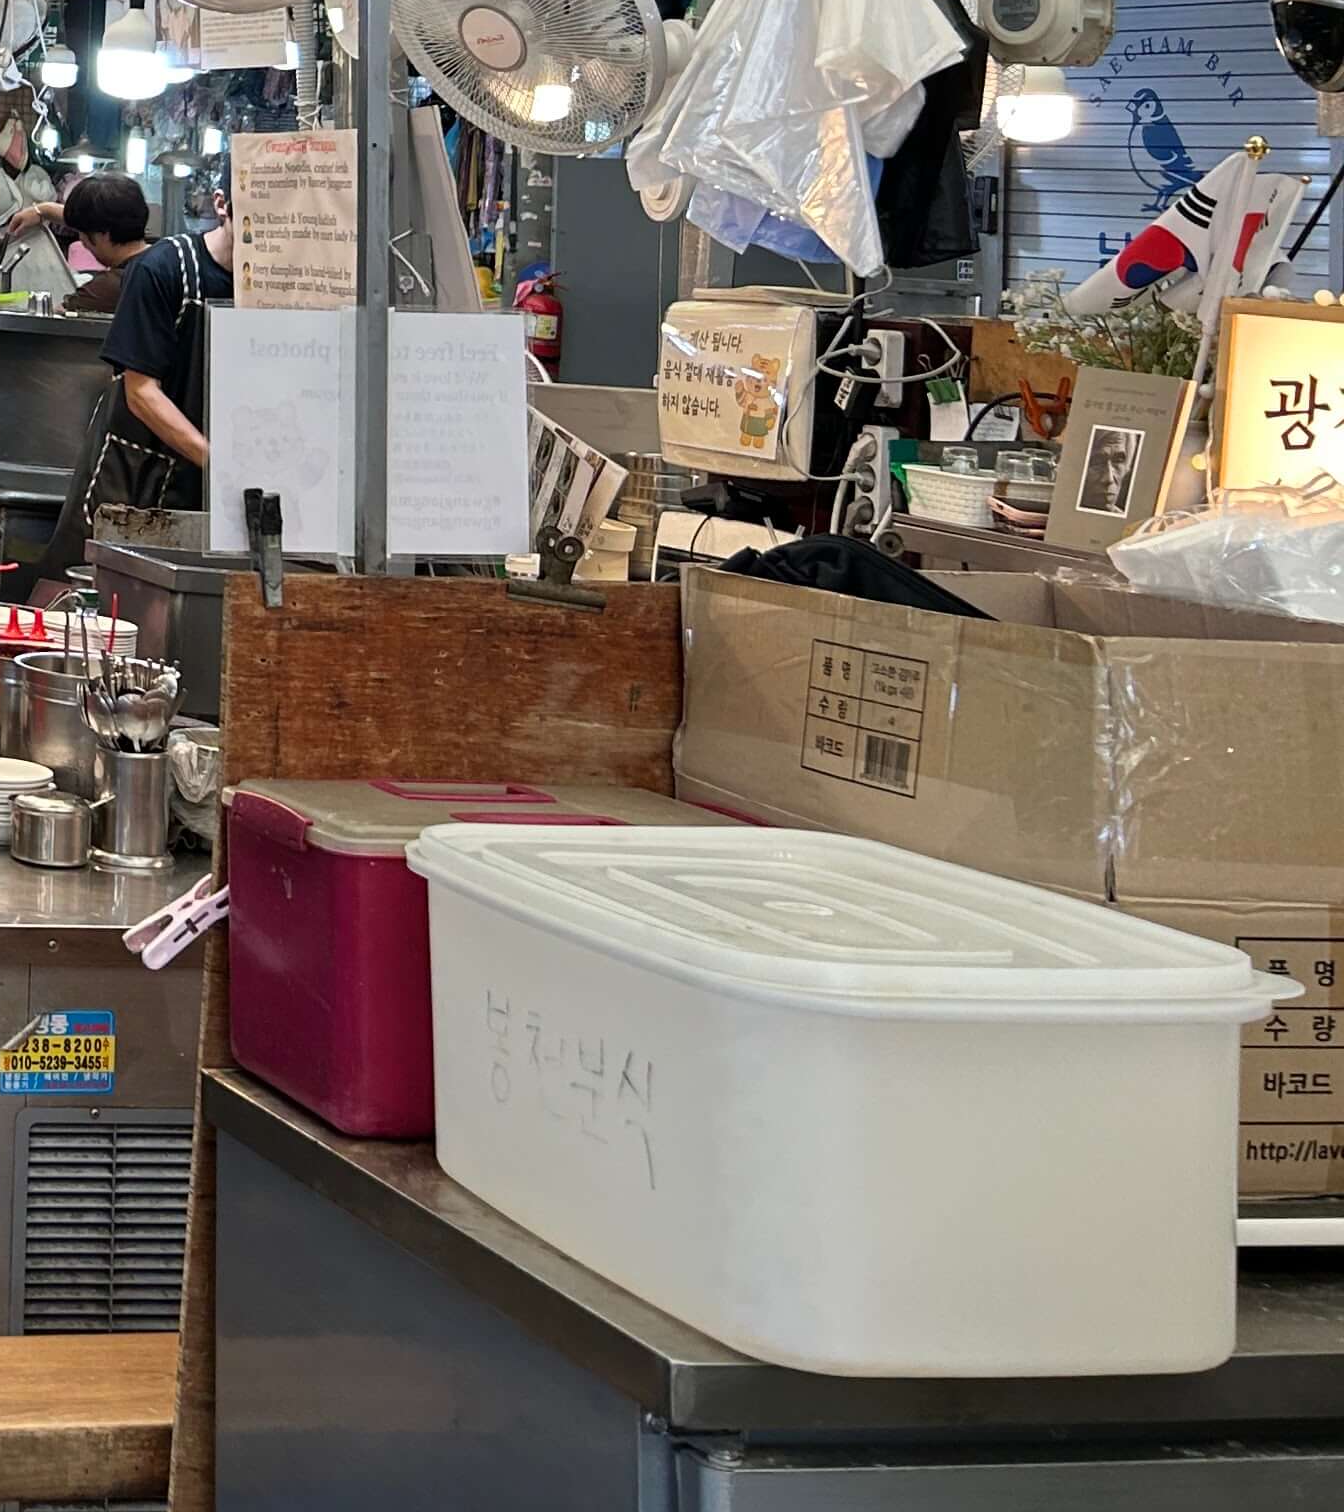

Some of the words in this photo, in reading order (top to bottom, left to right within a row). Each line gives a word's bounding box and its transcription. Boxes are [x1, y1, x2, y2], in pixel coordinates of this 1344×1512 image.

[1088, 36, 1194, 108] SAECHAM
[1203, 53, 1245, 108] BAR
[712, 332, 744, 354] 됩니다.
[664, 359, 682, 380] 음식
[684, 362, 704, 384] 절대
[662, 393, 679, 412] 하지
[682, 394, 721, 419] 않습니다.
[814, 735, 845, 758] 바코드
[11, 1055, 102, 1070] 010-5239-3455
[1263, 1070, 1333, 1099] 바코드
